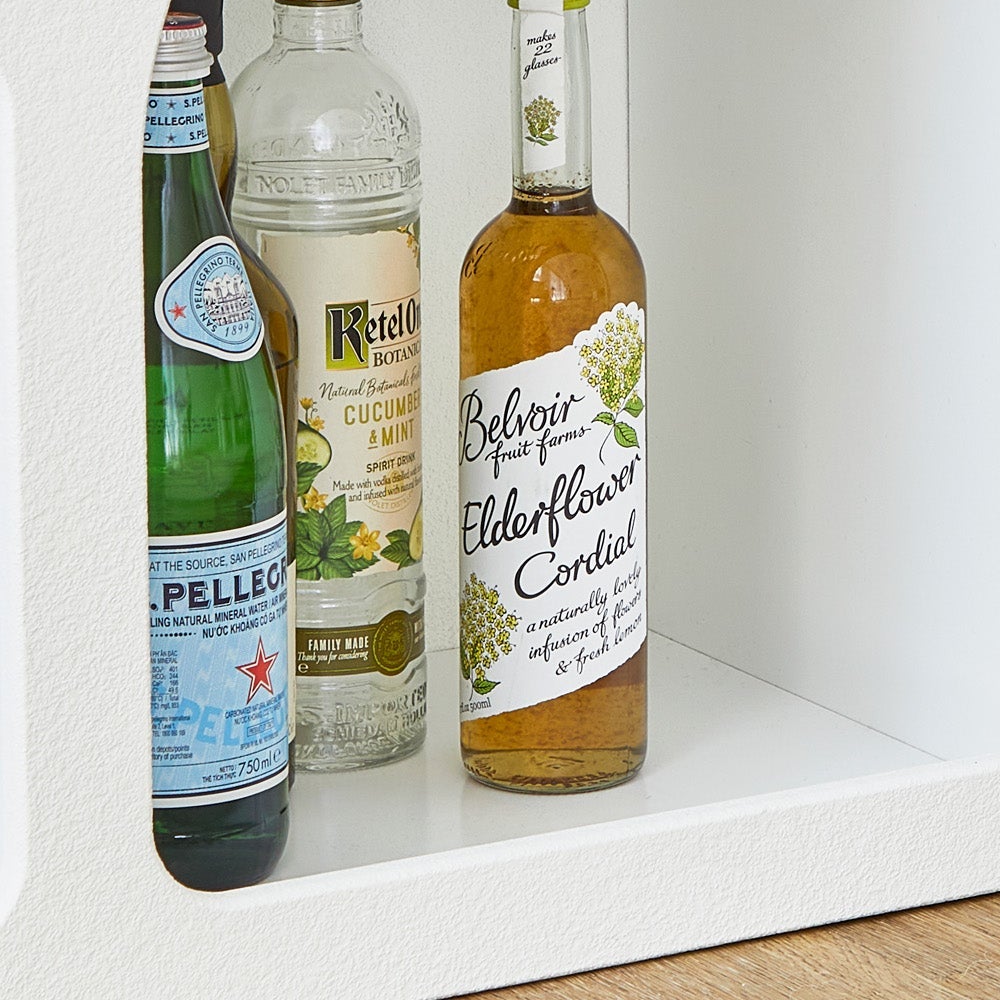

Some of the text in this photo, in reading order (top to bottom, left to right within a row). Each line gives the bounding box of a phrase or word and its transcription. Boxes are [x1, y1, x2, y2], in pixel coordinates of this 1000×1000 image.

[526, 29, 557, 46] makes
[533, 42, 553, 56] 22
[522, 56, 562, 80] glasses
[194, 256, 224, 310] PELLEGRINO
[200, 312, 218, 333] SAN
[327, 302, 404, 364] Ketel
[318, 378, 367, 401] Natural
[369, 418, 414, 447] & MINT
[459, 386, 586, 466] Belvoir
[484, 425, 592, 480] fruit farms
[366, 458, 395, 473] SPIRIT
[333, 480, 355, 491] Made
[356, 478, 372, 489] with
[348, 490, 362, 502] and
[363, 486, 387, 500] infused
[461, 453, 642, 556] Elderflower
[149, 560, 161, 572] AT
[163, 560, 183, 571] THE
[185, 555, 228, 571] SOURCE,
[229, 552, 247, 565] SAN
[513, 508, 637, 600] Cordial
[172, 614, 213, 627] NATURAL
[214, 608, 248, 623] MINERAL
[248, 600, 268, 616] WATER
[526, 622, 537, 634] a
[538, 587, 608, 631] naturally
[308, 635, 369, 651] FAMILY MADE
[528, 627, 590, 662] infusion
[592, 608, 609, 638] of
[297, 651, 317, 661] Thank
[316, 654, 328, 665] you
[327, 651, 338, 665] for
[555, 660, 572, 676] &
[573, 635, 610, 675] fresh
